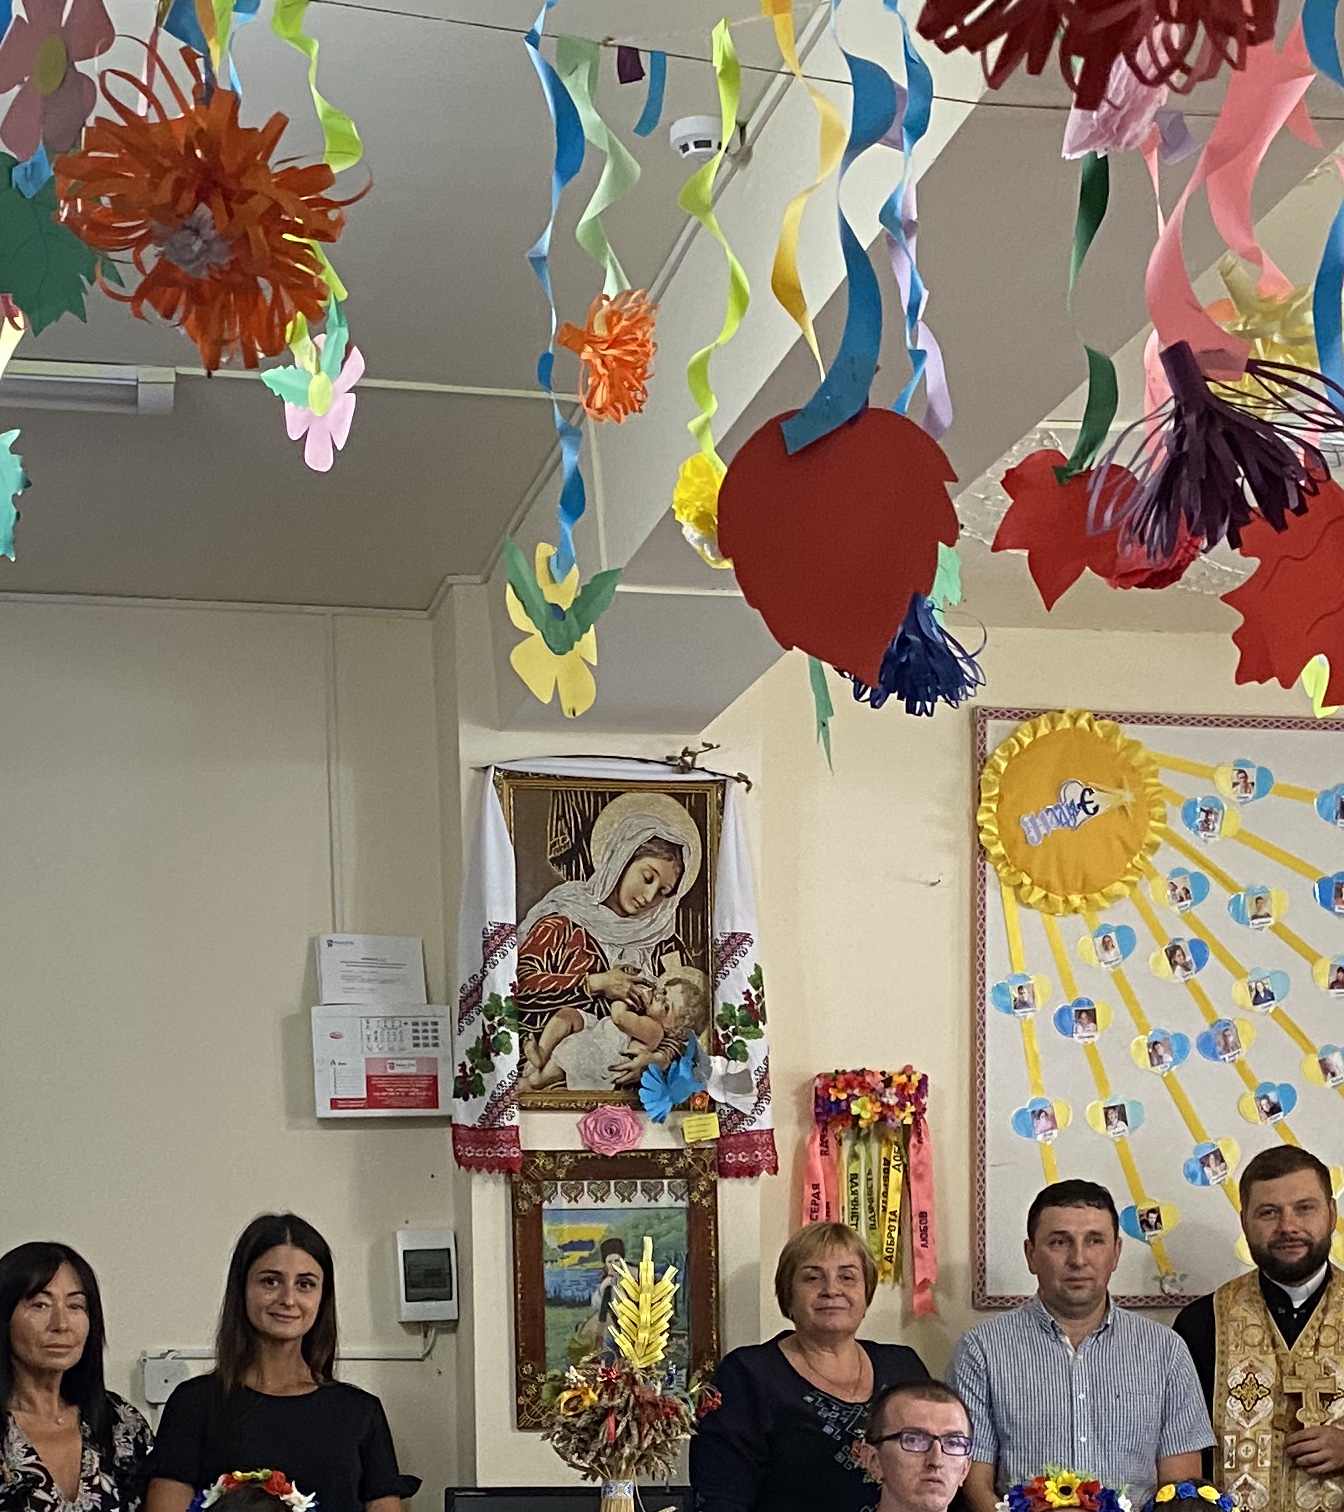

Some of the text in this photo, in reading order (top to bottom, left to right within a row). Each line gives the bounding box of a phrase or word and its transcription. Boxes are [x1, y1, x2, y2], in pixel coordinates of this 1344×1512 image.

[808, 1182, 822, 1222] СЕРДЯ
[883, 1208, 899, 1264] ДОБРОТА
[918, 1210, 930, 1249] ЛЮБОВ
